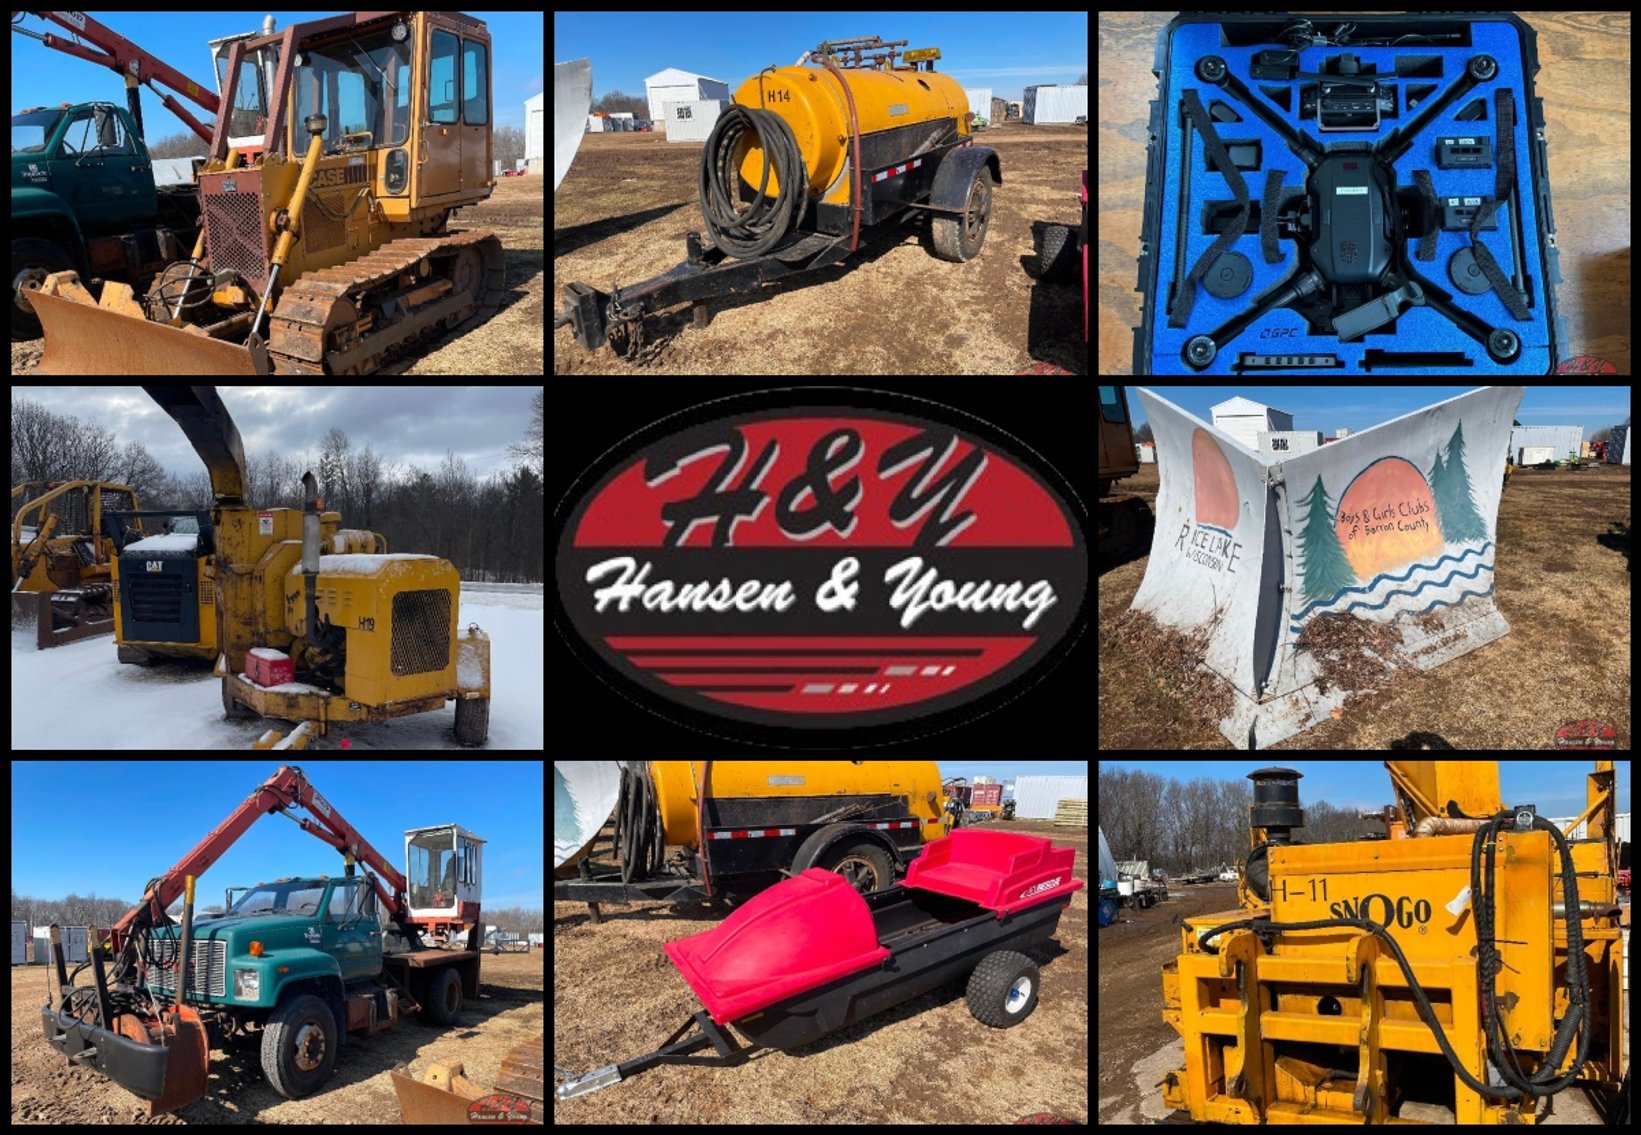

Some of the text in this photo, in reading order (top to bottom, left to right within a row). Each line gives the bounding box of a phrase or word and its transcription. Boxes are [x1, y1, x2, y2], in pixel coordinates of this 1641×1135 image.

[768, 90, 790, 102] H 14
[1340, 497, 1431, 525] Boys & Girls Clubs
[1348, 524, 1360, 540] of
[1397, 516, 1430, 532] County
[146, 560, 164, 572] CAT
